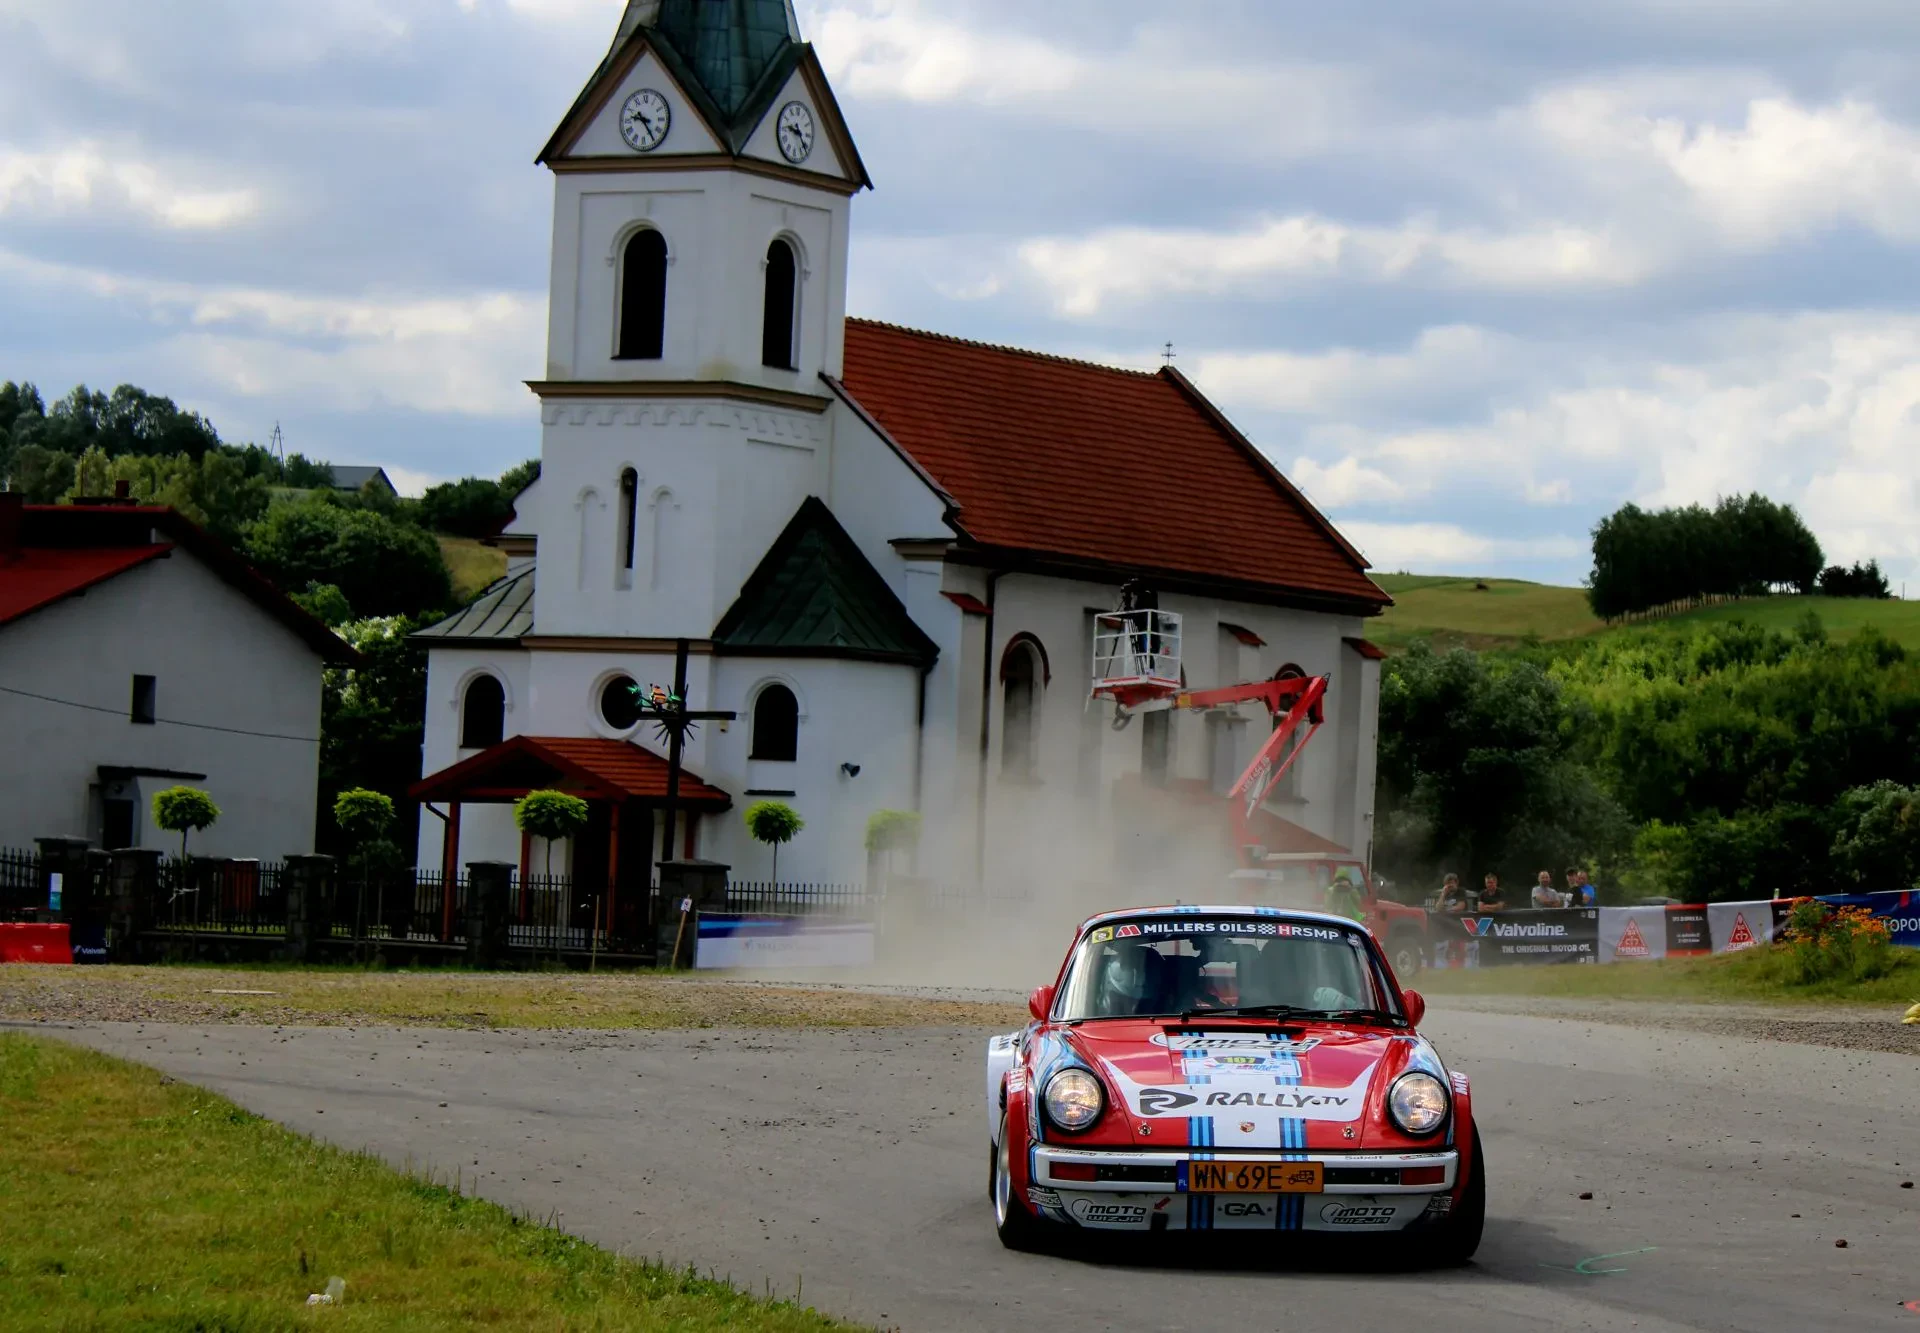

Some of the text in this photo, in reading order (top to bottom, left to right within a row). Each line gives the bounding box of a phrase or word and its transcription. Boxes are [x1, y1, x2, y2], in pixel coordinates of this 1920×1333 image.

[1144, 923, 1339, 940] MILLERS OILS HRSMP
[1493, 923, 1566, 937] Valvoline
[1883, 918, 1920, 932] OPO
[1502, 943, 1591, 953] THE ORIGINAL MOTOR OIL
[1194, 1164, 1282, 1189] WN 69E
[1088, 1205, 1147, 1215] MOTO
[1336, 1207, 1396, 1216] MOTO
